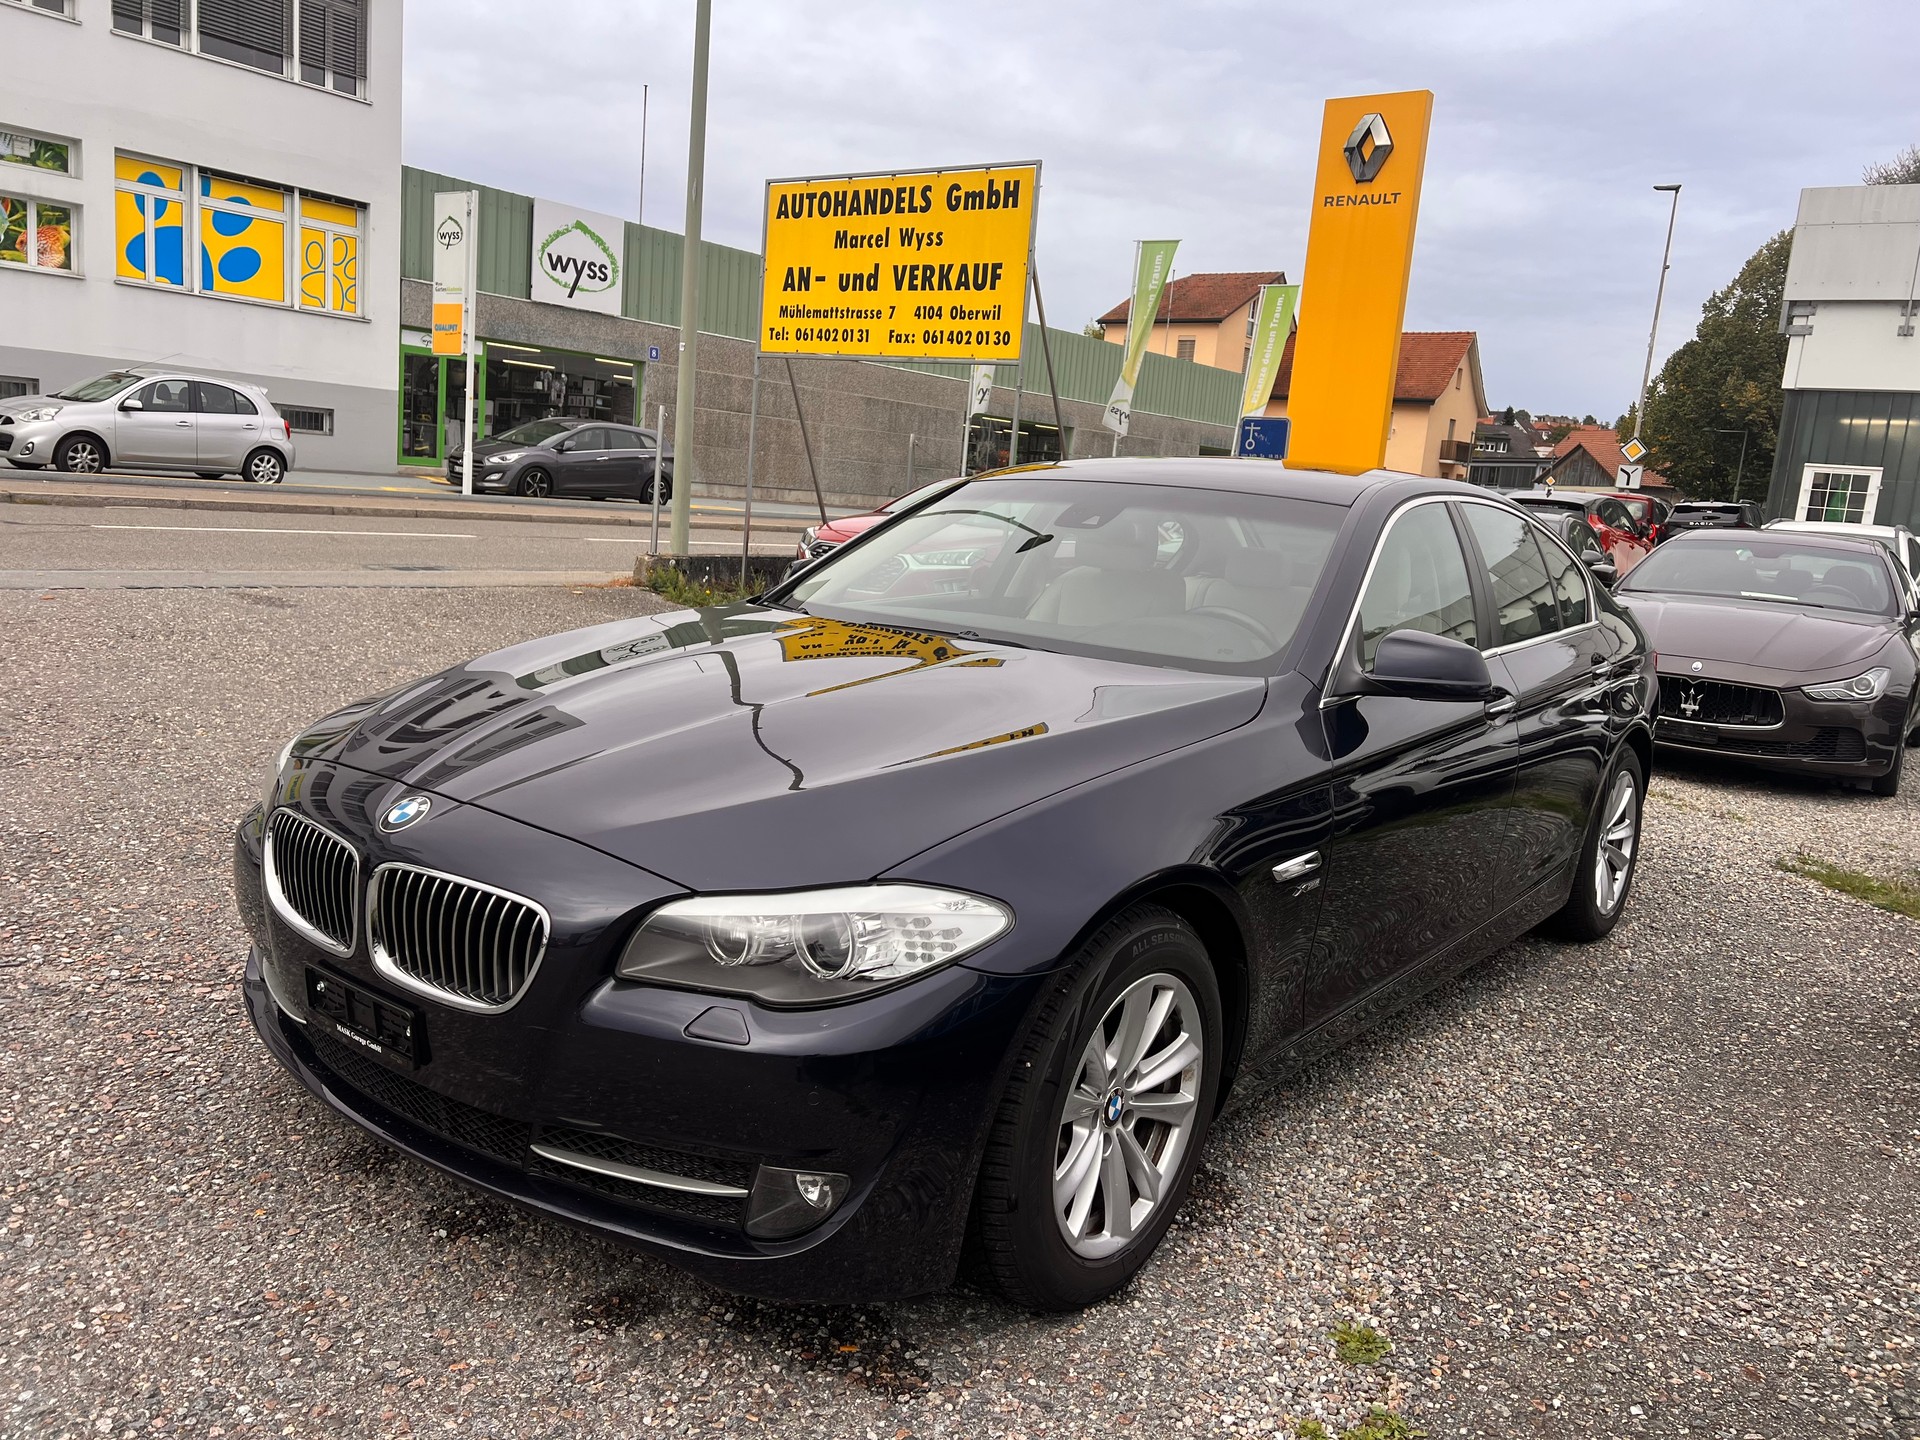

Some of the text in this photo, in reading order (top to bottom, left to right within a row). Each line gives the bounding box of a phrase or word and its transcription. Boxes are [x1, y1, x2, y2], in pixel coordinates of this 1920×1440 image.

[776, 179, 1020, 219] AUTOHANDELS GmbH
[1324, 193, 1401, 207] RENAULT
[440, 232, 460, 250] wyss
[834, 227, 944, 251] Marcel Wyss
[546, 252, 608, 299] wyss
[838, 263, 880, 292] und
[893, 262, 1003, 292] VERKAUF
[1148, 250, 1164, 290] Traum.
[779, 304, 1002, 321] Mühlemattstrasse 7 4104 Oberwil
[769, 326, 789, 340] Tel:
[888, 329, 915, 344] Fax:
[1261, 330, 1277, 365] deinen
[1270, 294, 1285, 329] Traum.
[651, 349, 657, 357] 8
[1132, 932, 1185, 958] ALL SEASON
